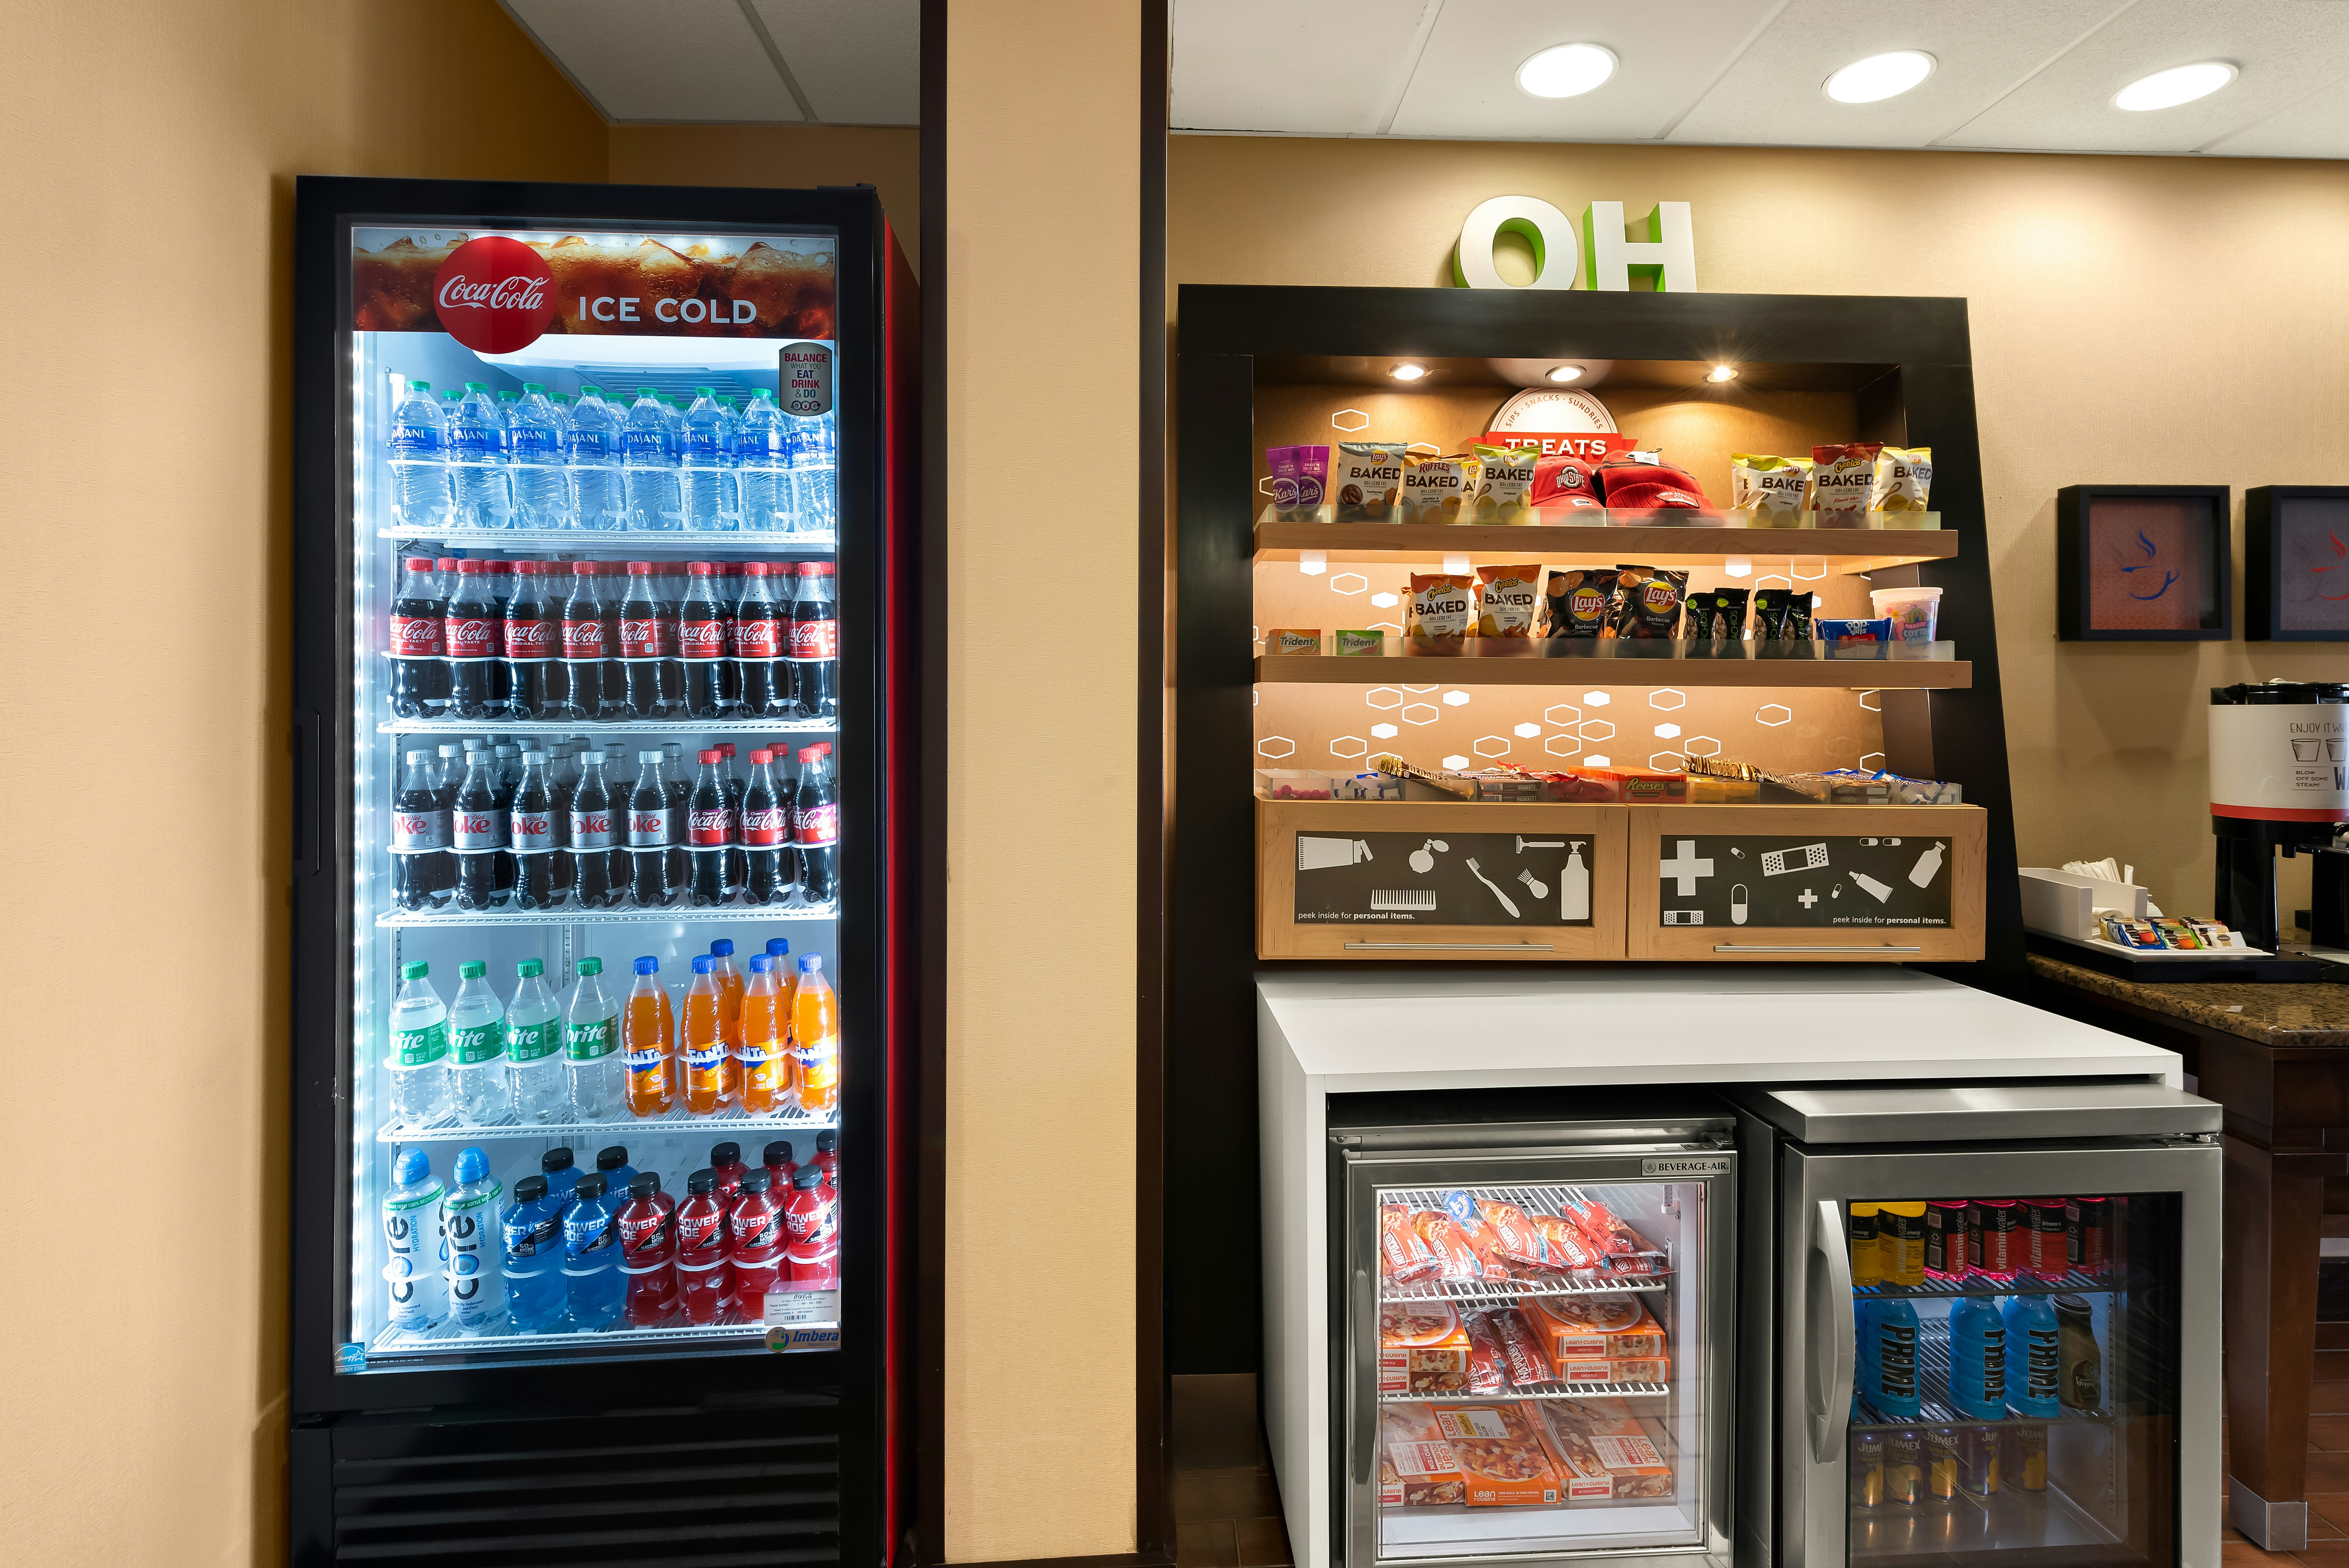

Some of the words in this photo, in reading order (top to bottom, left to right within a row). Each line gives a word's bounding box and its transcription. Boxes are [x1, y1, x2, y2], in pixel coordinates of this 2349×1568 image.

[1454, 195, 1698, 292] OH
[439, 275, 550, 311] Coca-Cola
[579, 296, 640, 322] ICE
[654, 298, 757, 325] COLD
[784, 353, 827, 362] BALANCE
[791, 379, 820, 388] DRINK
[795, 389, 802, 398] &
[804, 389, 816, 398] DO
[1506, 410, 1520, 428] SIPS
[1525, 394, 1559, 408] SNACKS
[1568, 397, 1603, 429] SUNDRIES
[393, 429, 425, 439] DASANI
[453, 428, 488, 441] DASANI
[512, 428, 546, 441] DASANI
[568, 430, 599, 444] DASANI
[628, 432, 661, 444] DASANI
[1371, 453, 1387, 462] Lay's
[1350, 467, 1401, 479] BAKED
[1419, 462, 1451, 474] RUFFLES
[1835, 459, 1862, 474] Cheetos
[1894, 466, 1932, 480] BAKED
[1406, 475, 1459, 488] BAKED
[1485, 468, 1534, 481] BAKED
[1819, 474, 1873, 487] BAKED
[1762, 478, 1806, 492] BAKE
[1273, 486, 1296, 501] Kar's
[1427, 584, 1452, 601] Cheetos
[1495, 578, 1519, 593] Cheetos
[1485, 593, 1533, 606] BAKED
[1574, 595, 1603, 613] Lay's
[1646, 588, 1676, 606] Lay's
[1415, 600, 1466, 615] BAKED
[505, 622, 556, 641] Coca-Cola
[678, 622, 725, 641] Coca-Cola
[1280, 636, 1314, 647] Trident
[1342, 638, 1375, 647] Trident
[2290, 723, 2320, 733] ENJOY
[2324, 723, 2330, 733] IT
[740, 807, 786, 830] Coca-Cola
[1298, 911, 1316, 921] peek
[1354, 912, 1388, 921] personal
[1833, 916, 1850, 925] peek
[1886, 917, 1920, 926] personal
[689, 1041, 731, 1065] FANTA
[1658, 1162, 1728, 1171] BEVERAGE-AIR
[420, 1194, 437, 1205] RECYCLED
[564, 1218, 606, 1232] POWER
[618, 1217, 658, 1230] POWER
[679, 1214, 720, 1227] POWER
[730, 1213, 766, 1228] POWER
[410, 1215, 420, 1252] HYDRATION
[476, 1212, 486, 1248] HYDRATION
[598, 1238, 611, 1246] MORE
[1896, 1217, 1907, 1272] vitaminwater
[1956, 1211, 1964, 1271] vitaminwater
[1998, 1208, 2008, 1270] vitaminwater
[2030, 1206, 2042, 1269] vitaminwater
[448, 1216, 479, 1300] core
[792, 1330, 839, 1342] Imbera
[1880, 1322, 1916, 1400] PRIME
[2028, 1328, 2059, 1400] PRIME
[1460, 1415, 1472, 1434] Comfort
[1924, 1431, 1959, 1445] JUMEX
[1421, 1445, 1436, 1470] PROTEIN
[1622, 1439, 1641, 1463] PROTEIN
